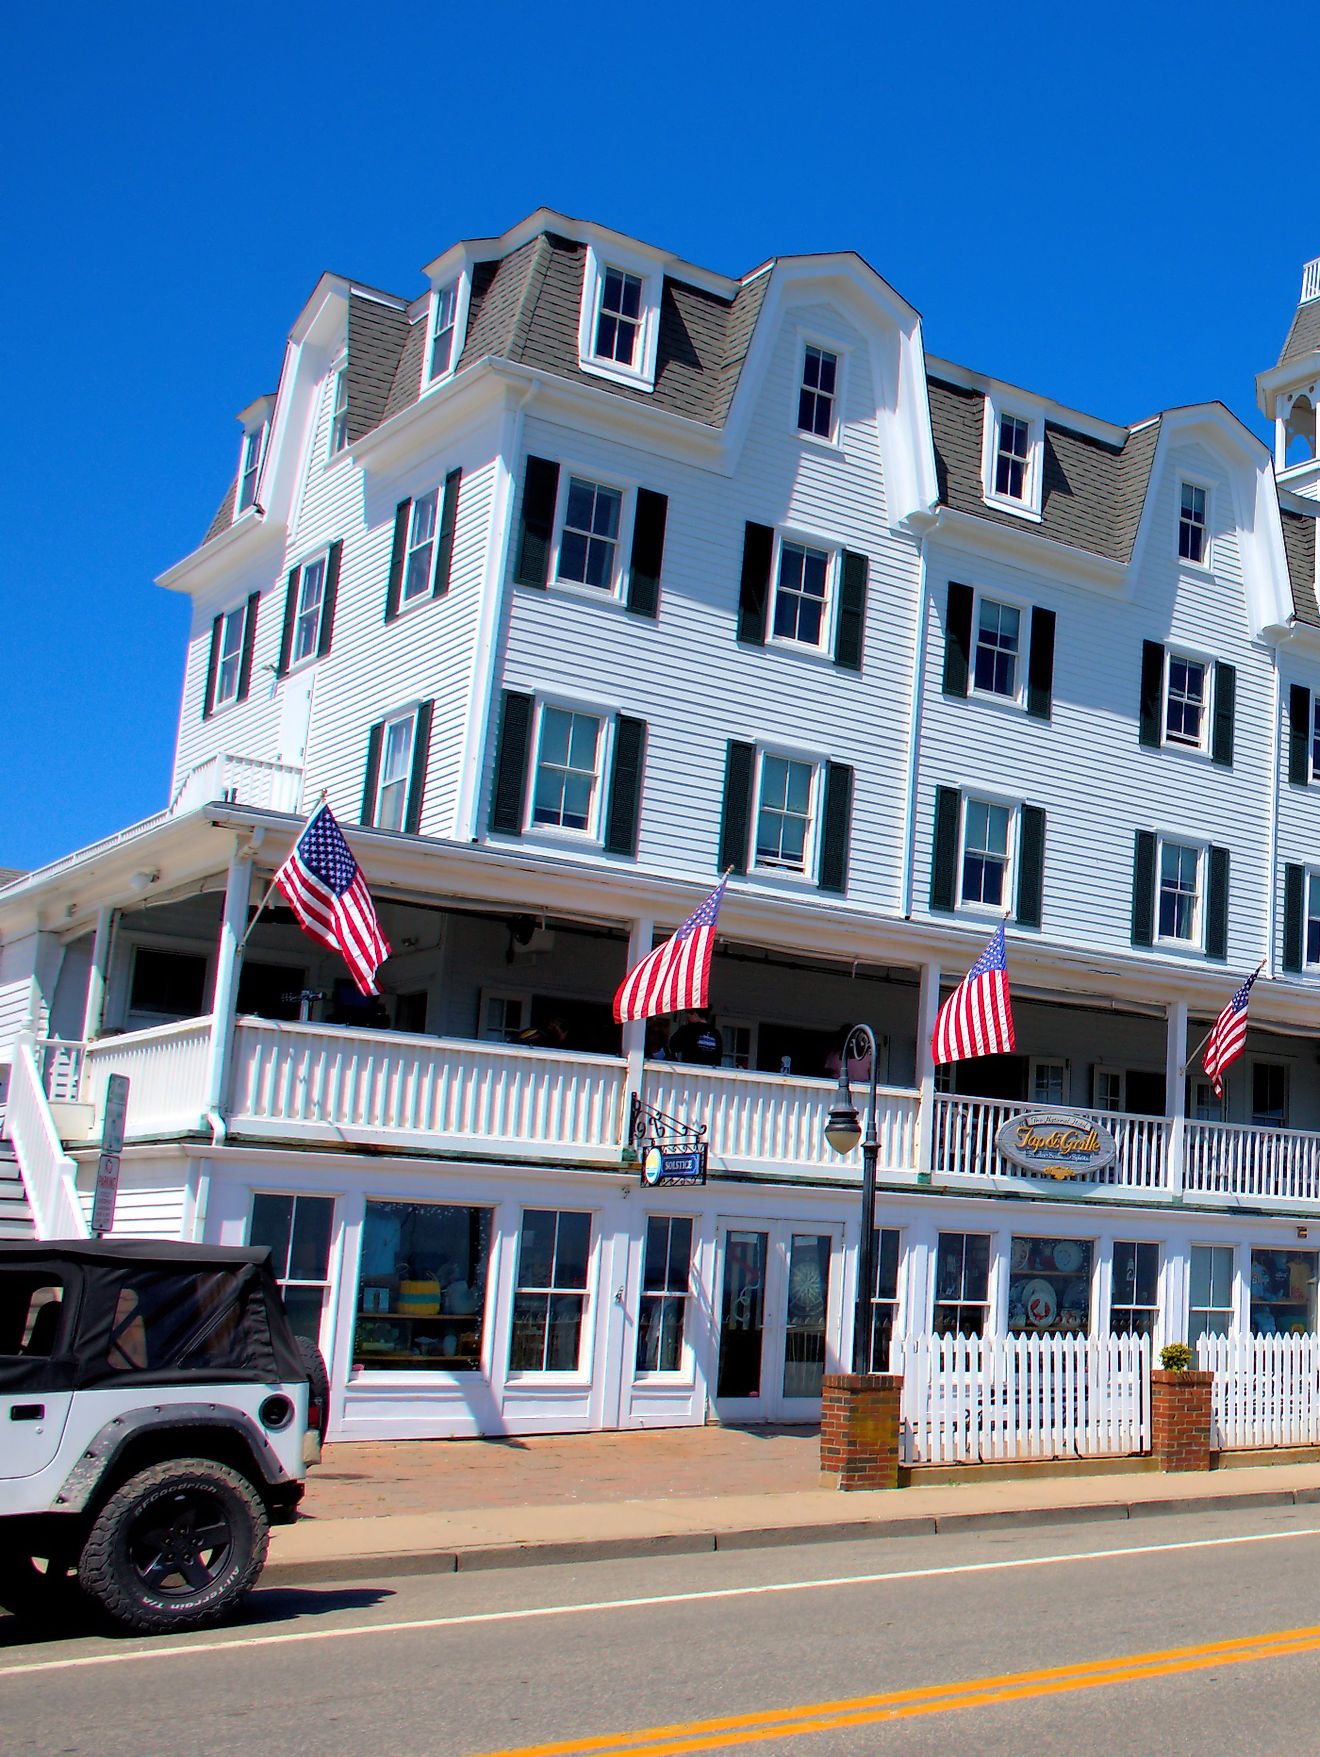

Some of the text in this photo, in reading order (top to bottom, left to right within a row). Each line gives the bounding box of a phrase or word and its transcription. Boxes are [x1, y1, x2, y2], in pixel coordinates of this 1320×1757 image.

[1014, 1125, 1044, 1153] Tap
[1060, 1129, 1101, 1155] Grille
[665, 1160, 693, 1171] SOLSTICE
[134, 1481, 218, 1517] BFGoodrich
[142, 1565, 240, 1610] All-Terrain T/A
